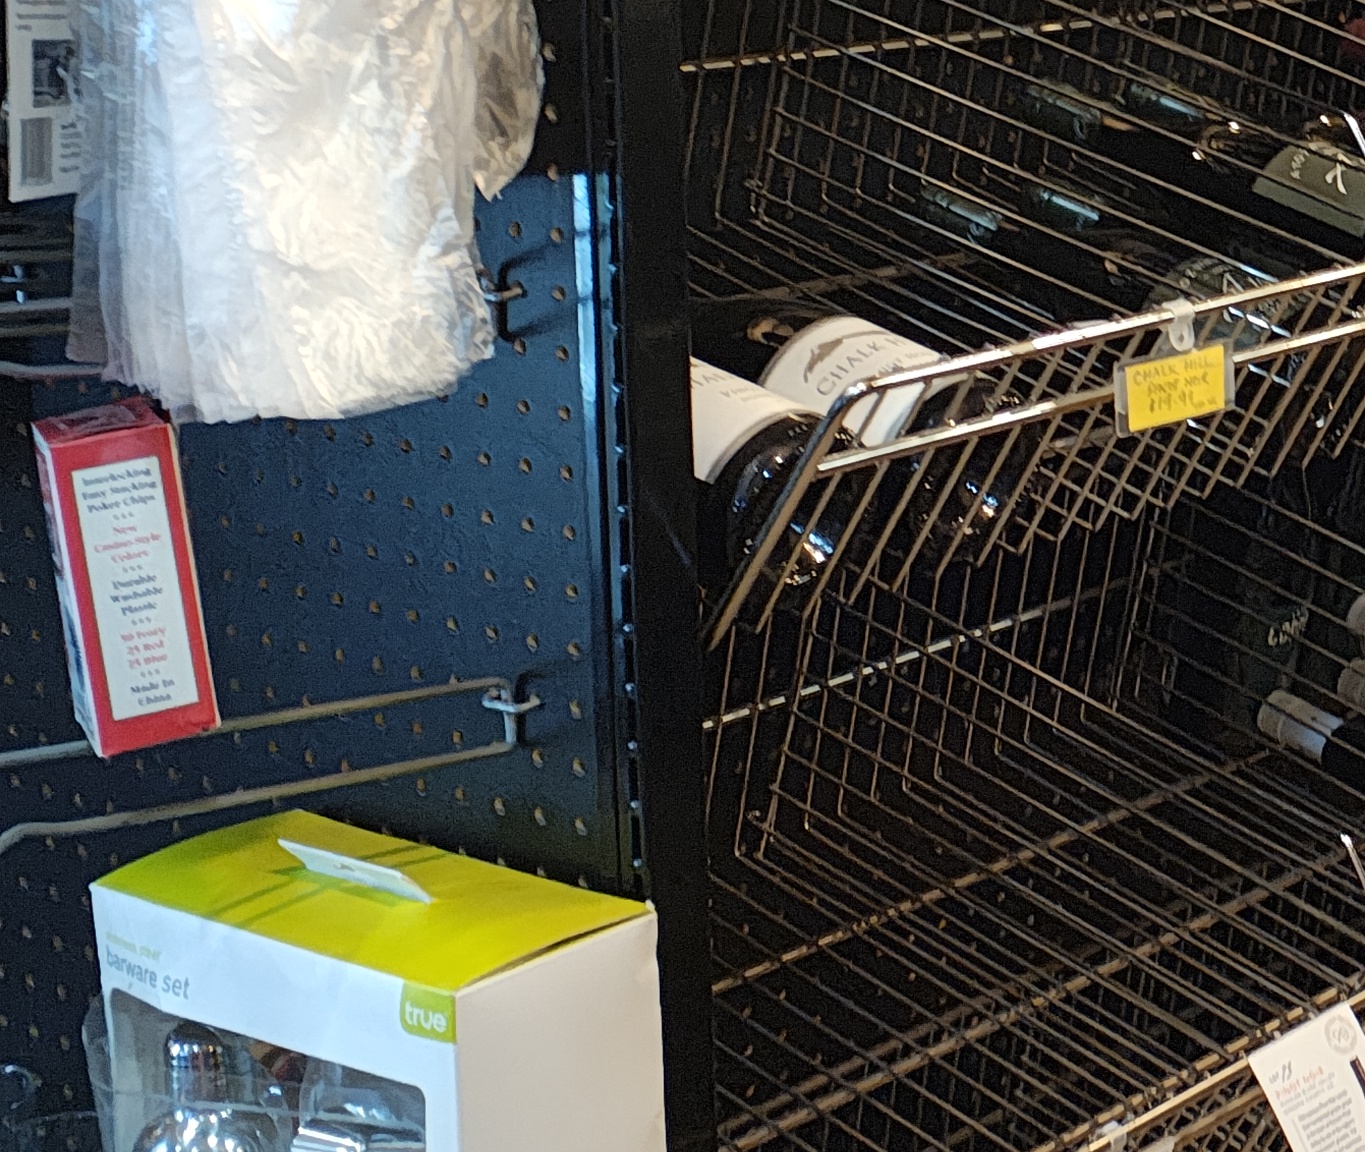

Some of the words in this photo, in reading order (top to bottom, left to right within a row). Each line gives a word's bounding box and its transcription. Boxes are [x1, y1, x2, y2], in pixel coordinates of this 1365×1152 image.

[105, 943, 158, 989] barware
[161, 974, 191, 1001] set
[404, 1000, 448, 1034] true
